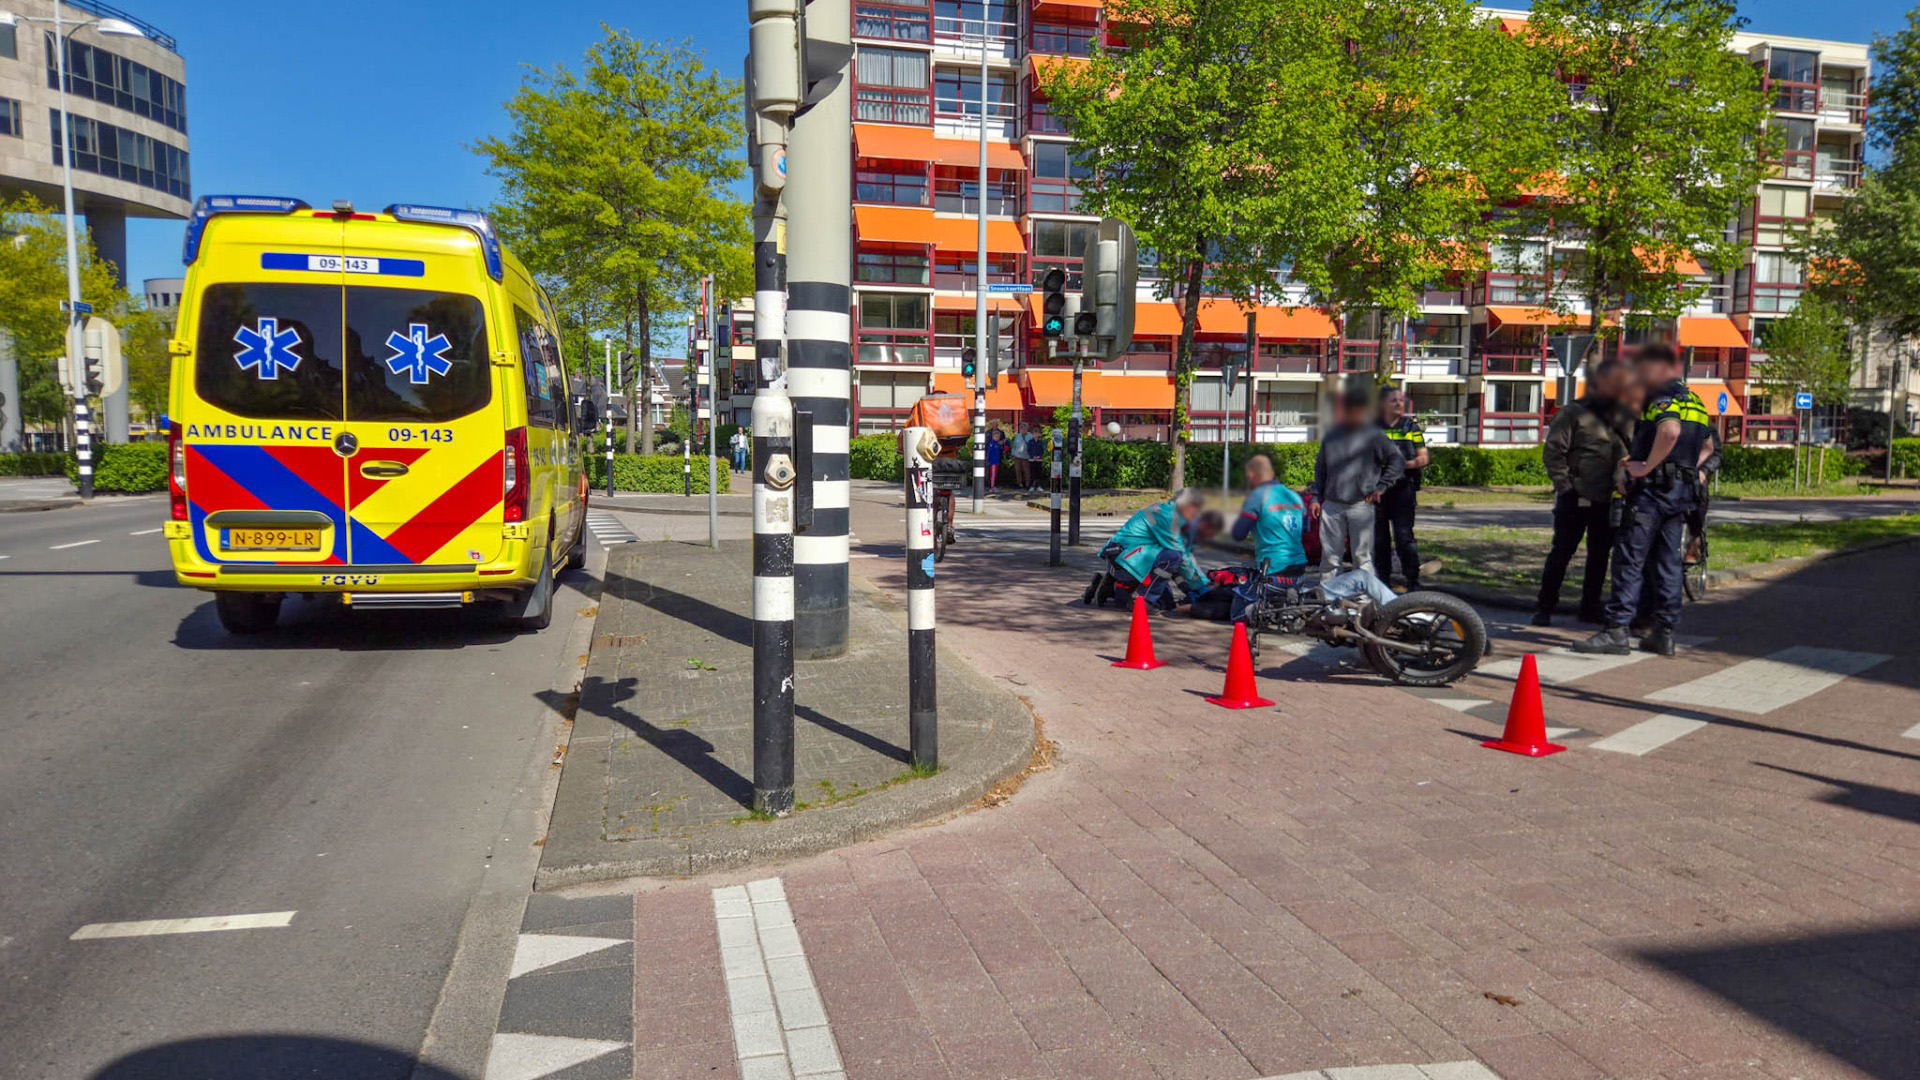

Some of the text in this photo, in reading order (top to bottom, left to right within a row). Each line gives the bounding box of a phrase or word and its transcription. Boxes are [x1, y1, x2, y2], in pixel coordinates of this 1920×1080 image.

[319, 258, 368, 271] 09-143
[186, 424, 333, 440] AMBULANCE
[388, 428, 453, 442] 09-143
[235, 531, 314, 546] N-899-LR
